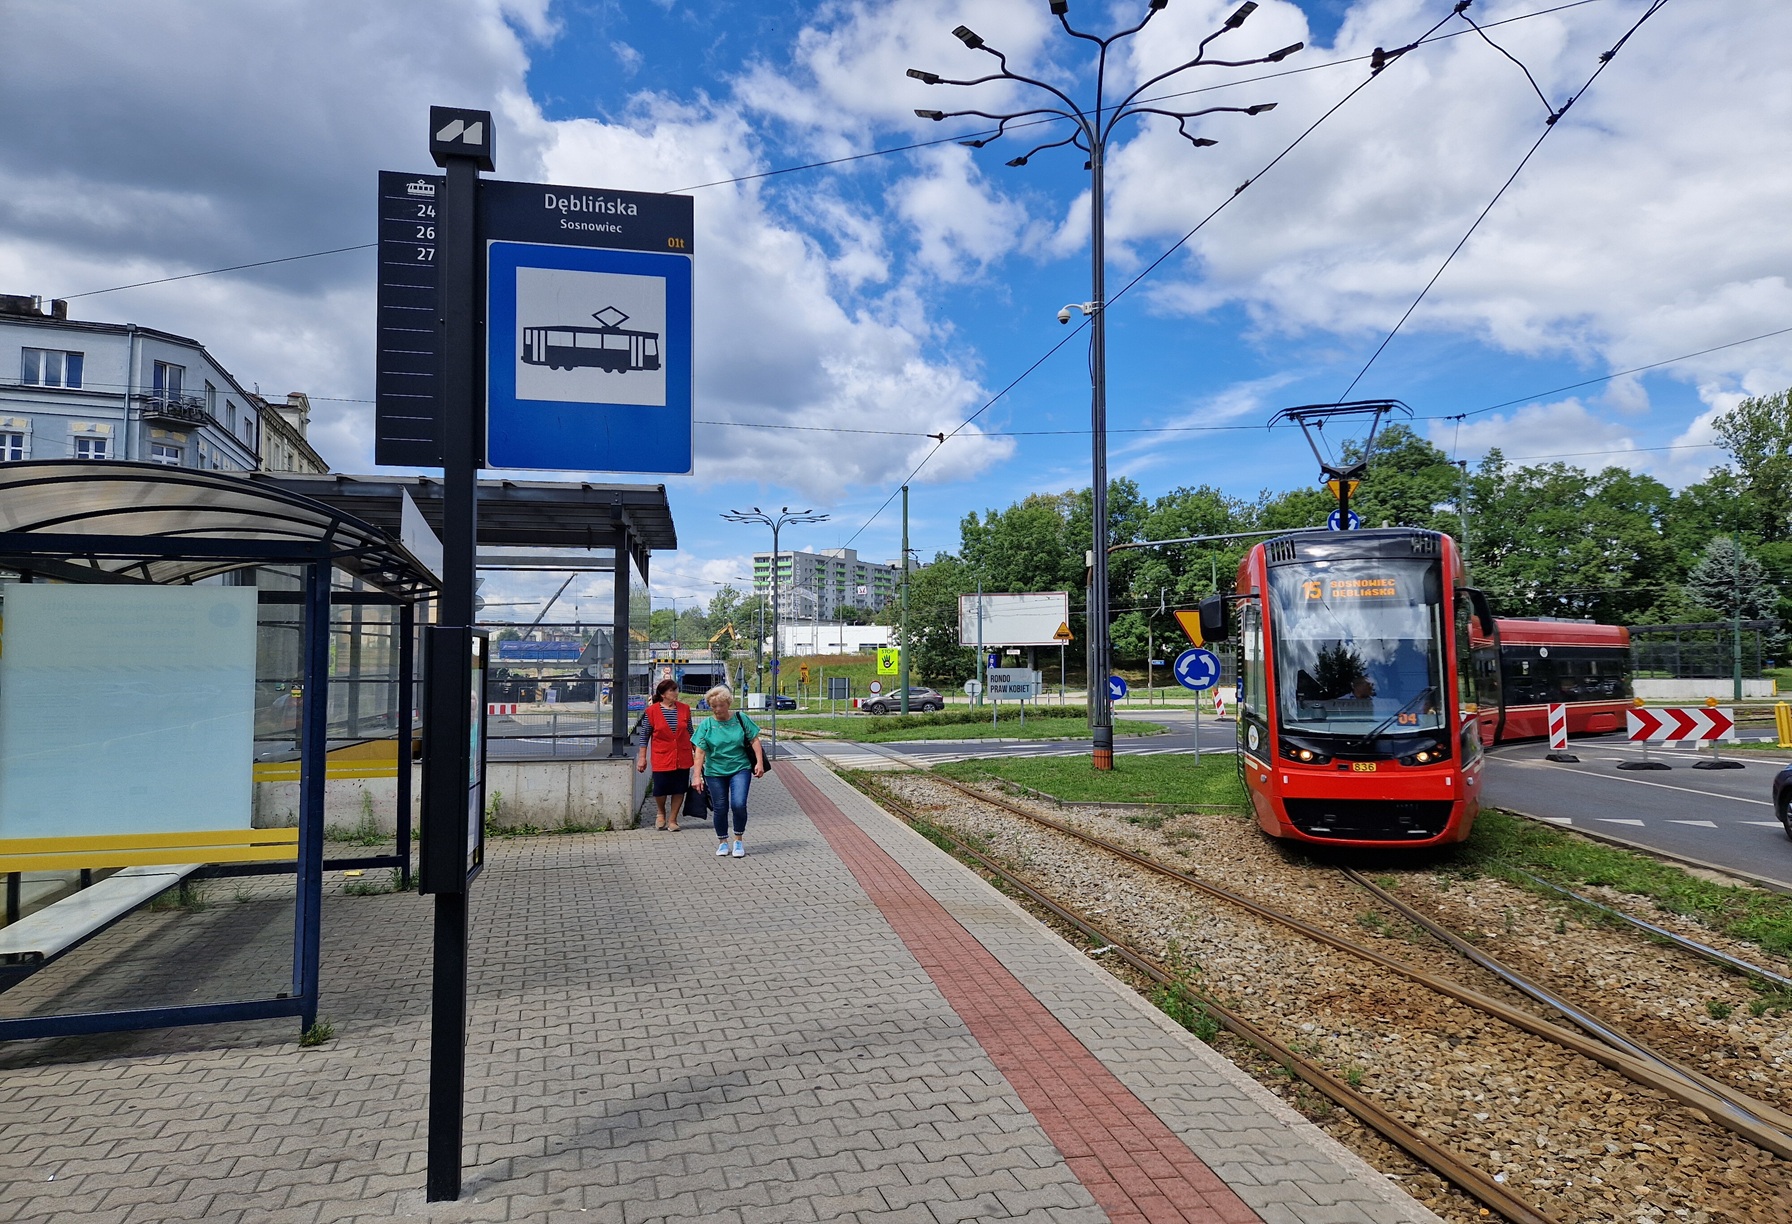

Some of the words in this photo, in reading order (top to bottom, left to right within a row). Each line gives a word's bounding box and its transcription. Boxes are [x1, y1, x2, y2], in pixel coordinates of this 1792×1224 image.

[417, 204, 436, 218] 24
[544, 193, 638, 216] Dęblińska
[416, 225, 436, 240] 26
[560, 218, 623, 233] Sosnowiec
[667, 237, 685, 248] 01t
[417, 247, 436, 261] 27
[1301, 581, 1322, 599] 15
[1330, 578, 1396, 588] SOSNOWIEC
[990, 674, 1011, 682] RONDO
[990, 684, 1008, 693] PRAW
[1008, 684, 1030, 693] KOBIET
[1398, 713, 1417, 725] 04
[1354, 763, 1375, 772] 836
